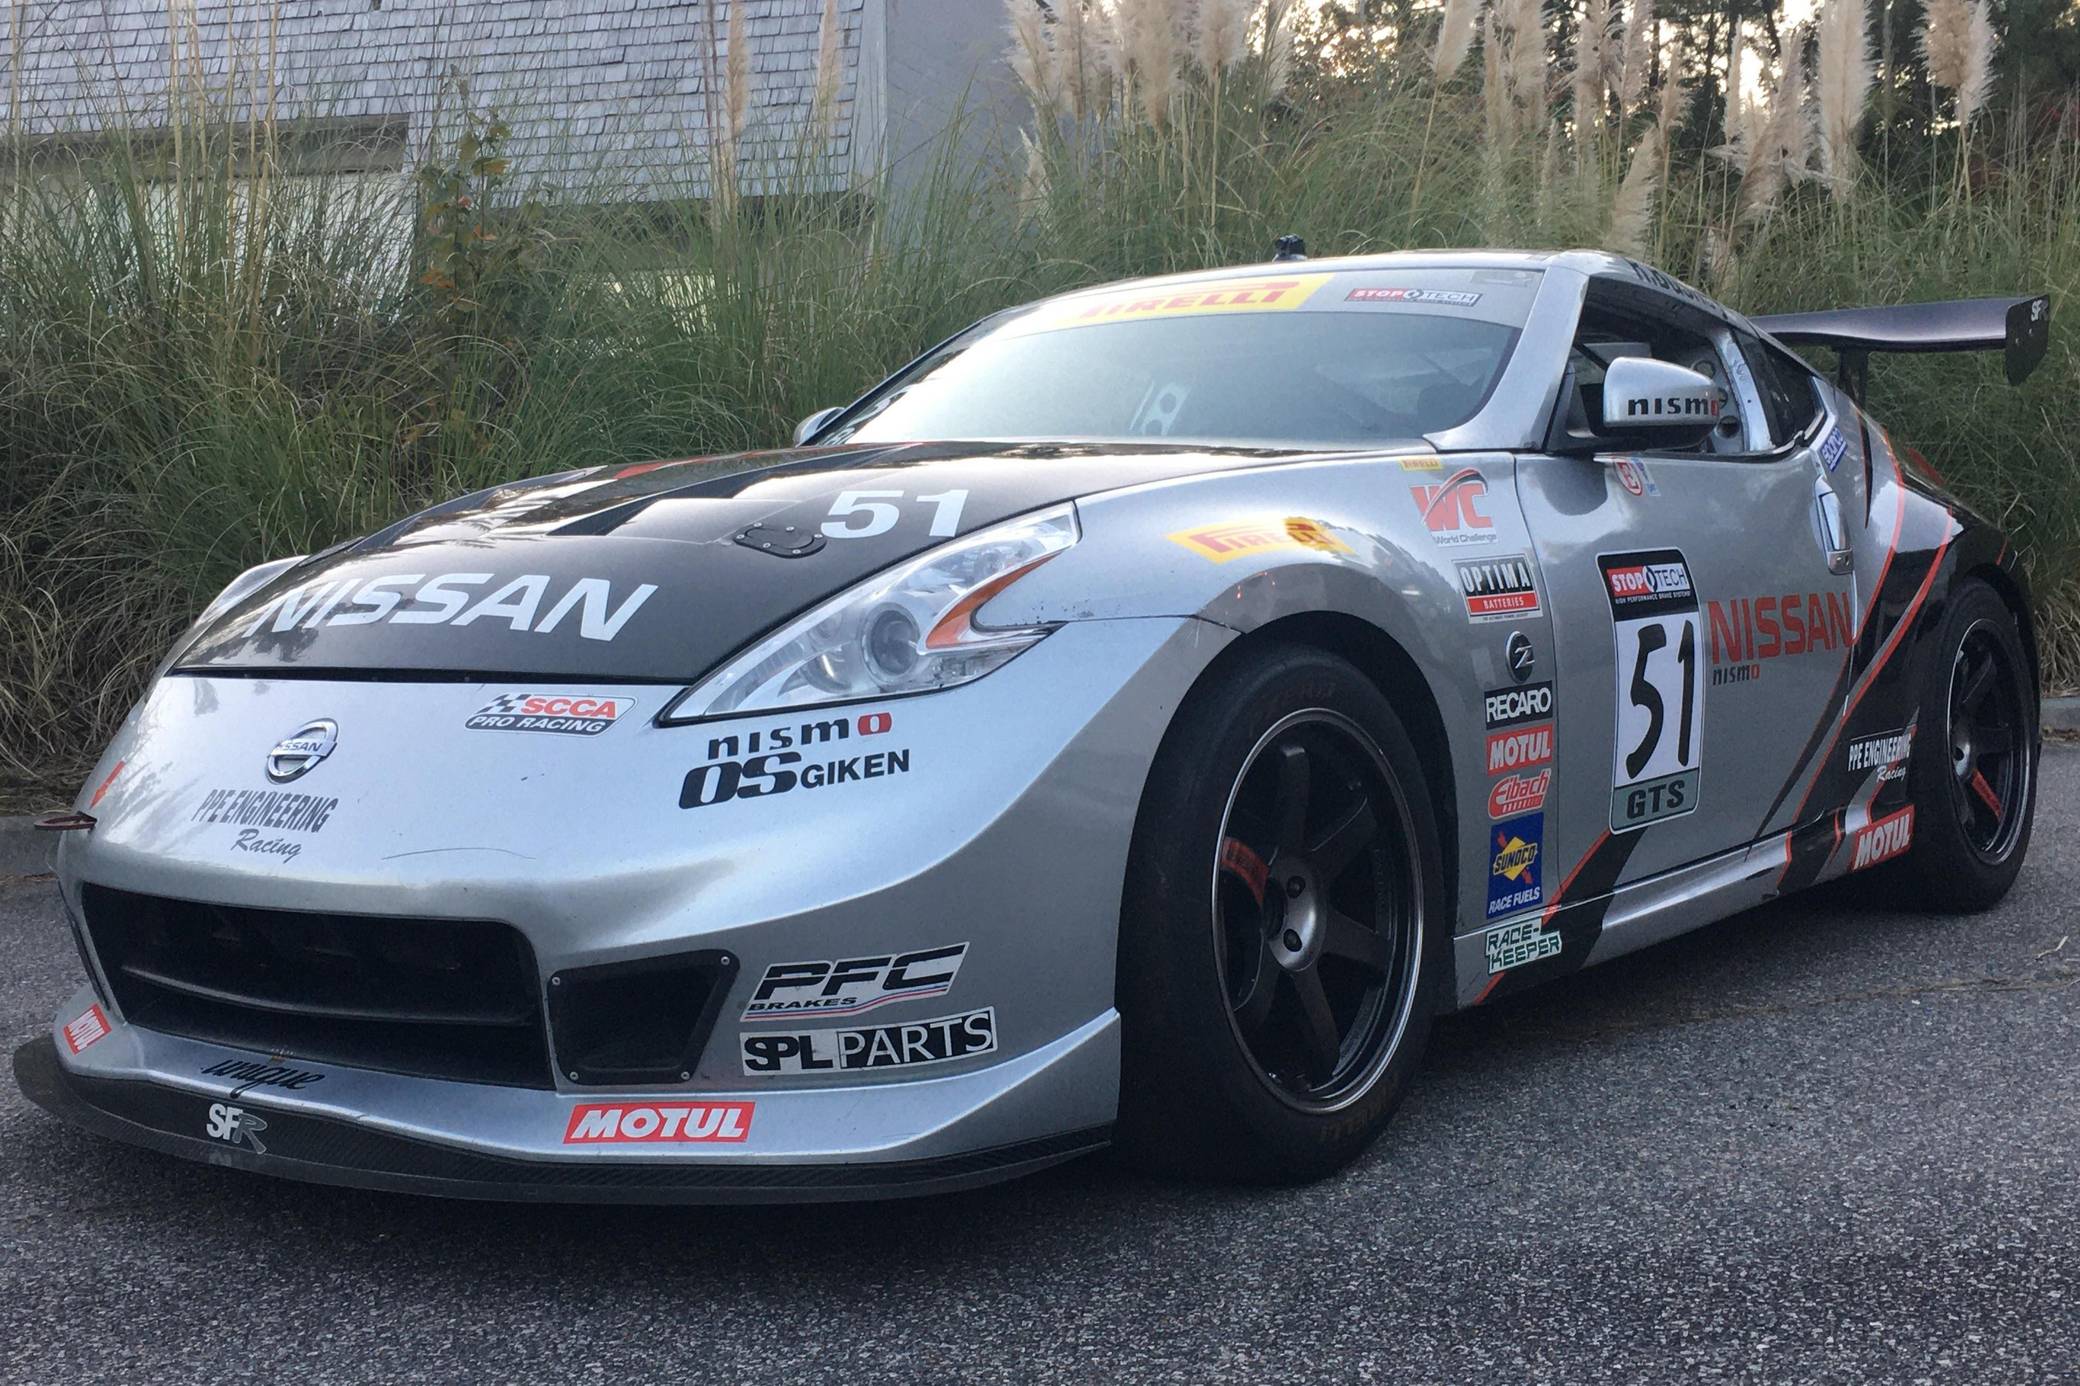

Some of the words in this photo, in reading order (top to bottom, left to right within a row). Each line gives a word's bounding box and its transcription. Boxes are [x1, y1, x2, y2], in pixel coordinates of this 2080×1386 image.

[1080, 281, 1301, 319] PIRELLI
[1353, 289, 1405, 298] STOP
[820, 489, 969, 539] 51
[1460, 562, 1531, 592] OPTIMA
[1612, 572, 1644, 592] STOP
[1655, 568, 1688, 588] TECH
[243, 573, 658, 642] NISSAN
[1483, 597, 1524, 609] BATTERIES
[1707, 591, 1851, 665] NISSAN
[1712, 663, 1760, 686] nismo
[521, 697, 617, 719] SCCA
[1485, 687, 1551, 723] RECARO
[1626, 619, 1694, 780] 51
[468, 716, 516, 727] PRO
[517, 717, 607, 733] RACING
[708, 711, 892, 760] nismo
[1489, 731, 1551, 770] MOTUL
[1863, 733, 1911, 768] ENGINEERING
[679, 751, 802, 810] OS
[800, 749, 910, 789] GIKEN
[1877, 765, 1906, 783] Racing
[191, 788, 236, 823] PPE
[220, 790, 339, 833] ENGINEERING
[1488, 768, 1551, 819] Eibach
[1626, 780, 1686, 819] GTS
[231, 828, 302, 864] Racing
[1494, 845, 1536, 873] SUNOCO
[1854, 814, 1911, 870] MOTUL
[1488, 894, 1514, 915] RACE
[1513, 887, 1541, 906] FUELS
[754, 944, 967, 1000] PFC
[748, 997, 857, 1011] BRAKES
[570, 1107, 745, 1139] MOTUL
